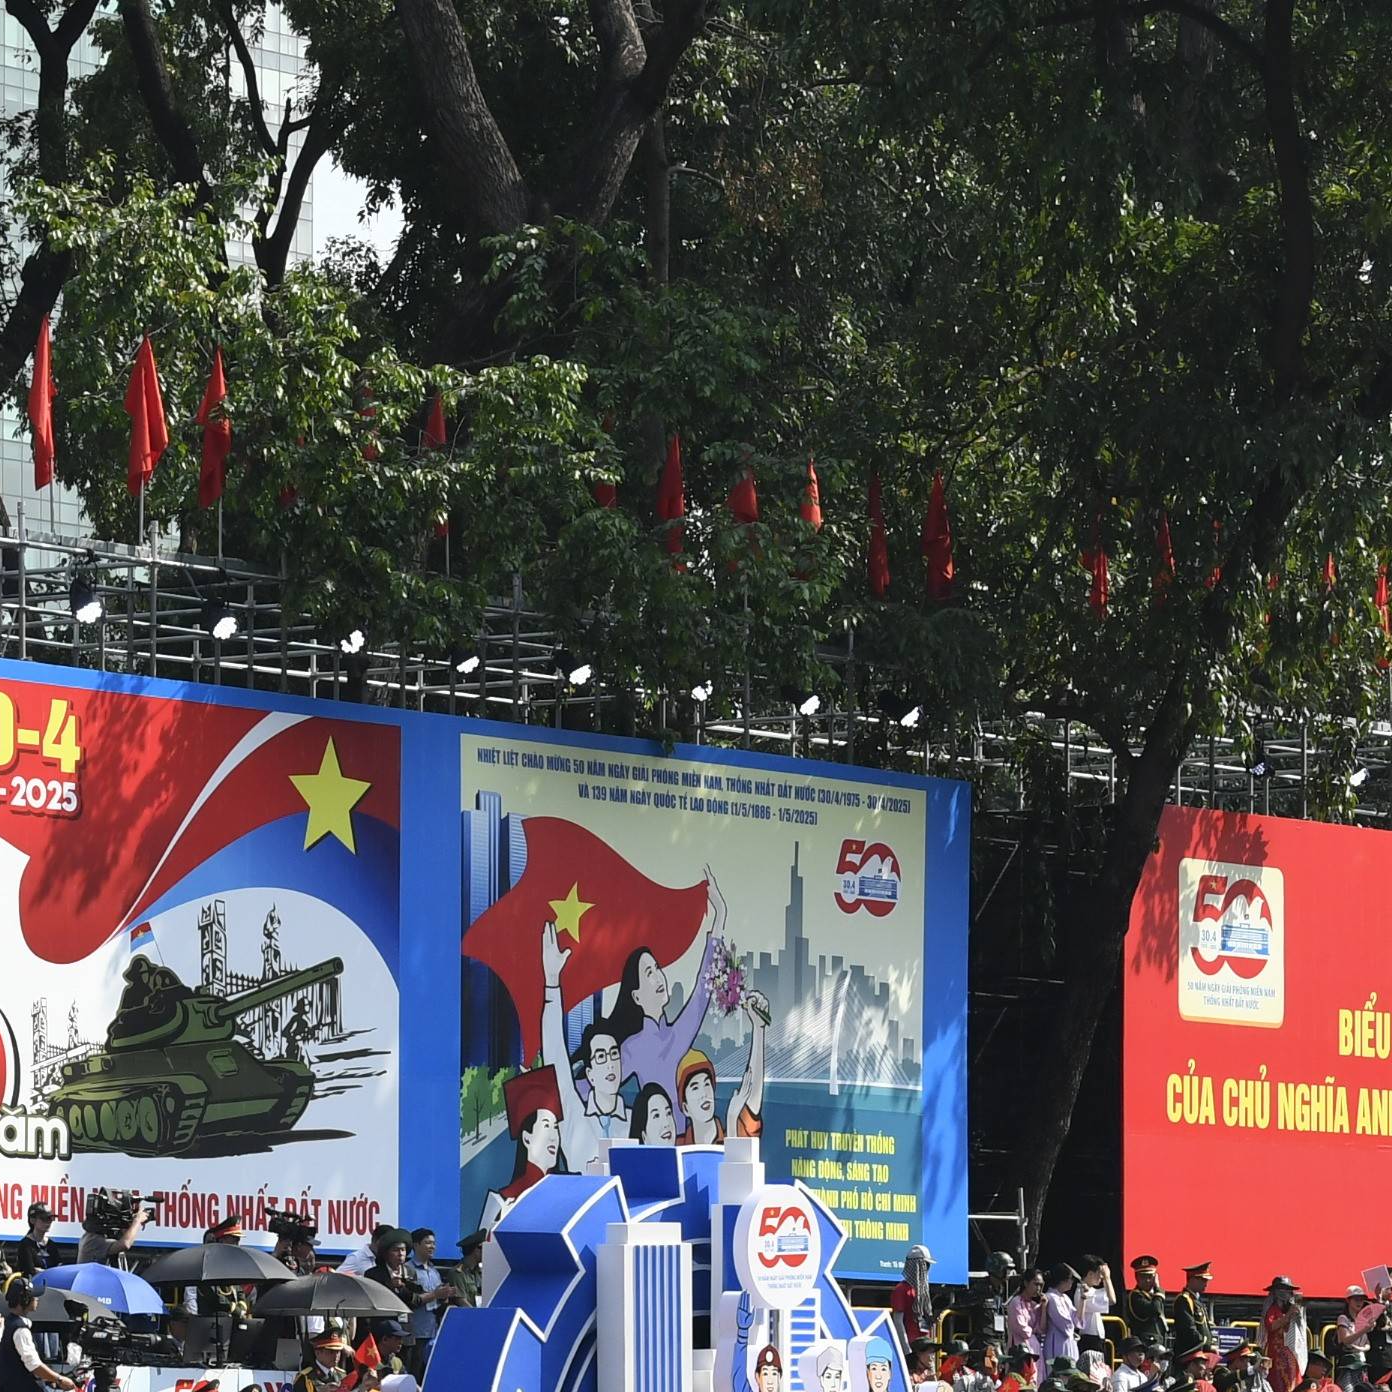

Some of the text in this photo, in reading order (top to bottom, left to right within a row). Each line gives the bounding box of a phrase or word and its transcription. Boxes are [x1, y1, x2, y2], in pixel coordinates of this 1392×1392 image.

[574, 760, 585, 774] 50
[592, 786, 607, 800] 139
[1338, 992, 1391, 1060] BIỂU
[1166, 1058, 1216, 1126] CỦA
[1222, 1063, 1270, 1130] CHỦ
[1277, 1075, 1350, 1135] NGHĨA
[786, 1128, 895, 1155] PHÁT HUY TRUYỀN THỐNG
[847, 1160, 870, 1181] SÁNG
[872, 1163, 889, 1185] TẠO
[153, 1179, 219, 1229] THỐNG
[328, 1193, 380, 1235] NƯỚC
[810, 1186, 917, 1212] HÀNH PHỐ HỒ CHÍ MINH
[854, 1218, 884, 1240] THÔNG
[886, 1222, 909, 1241] MINH
